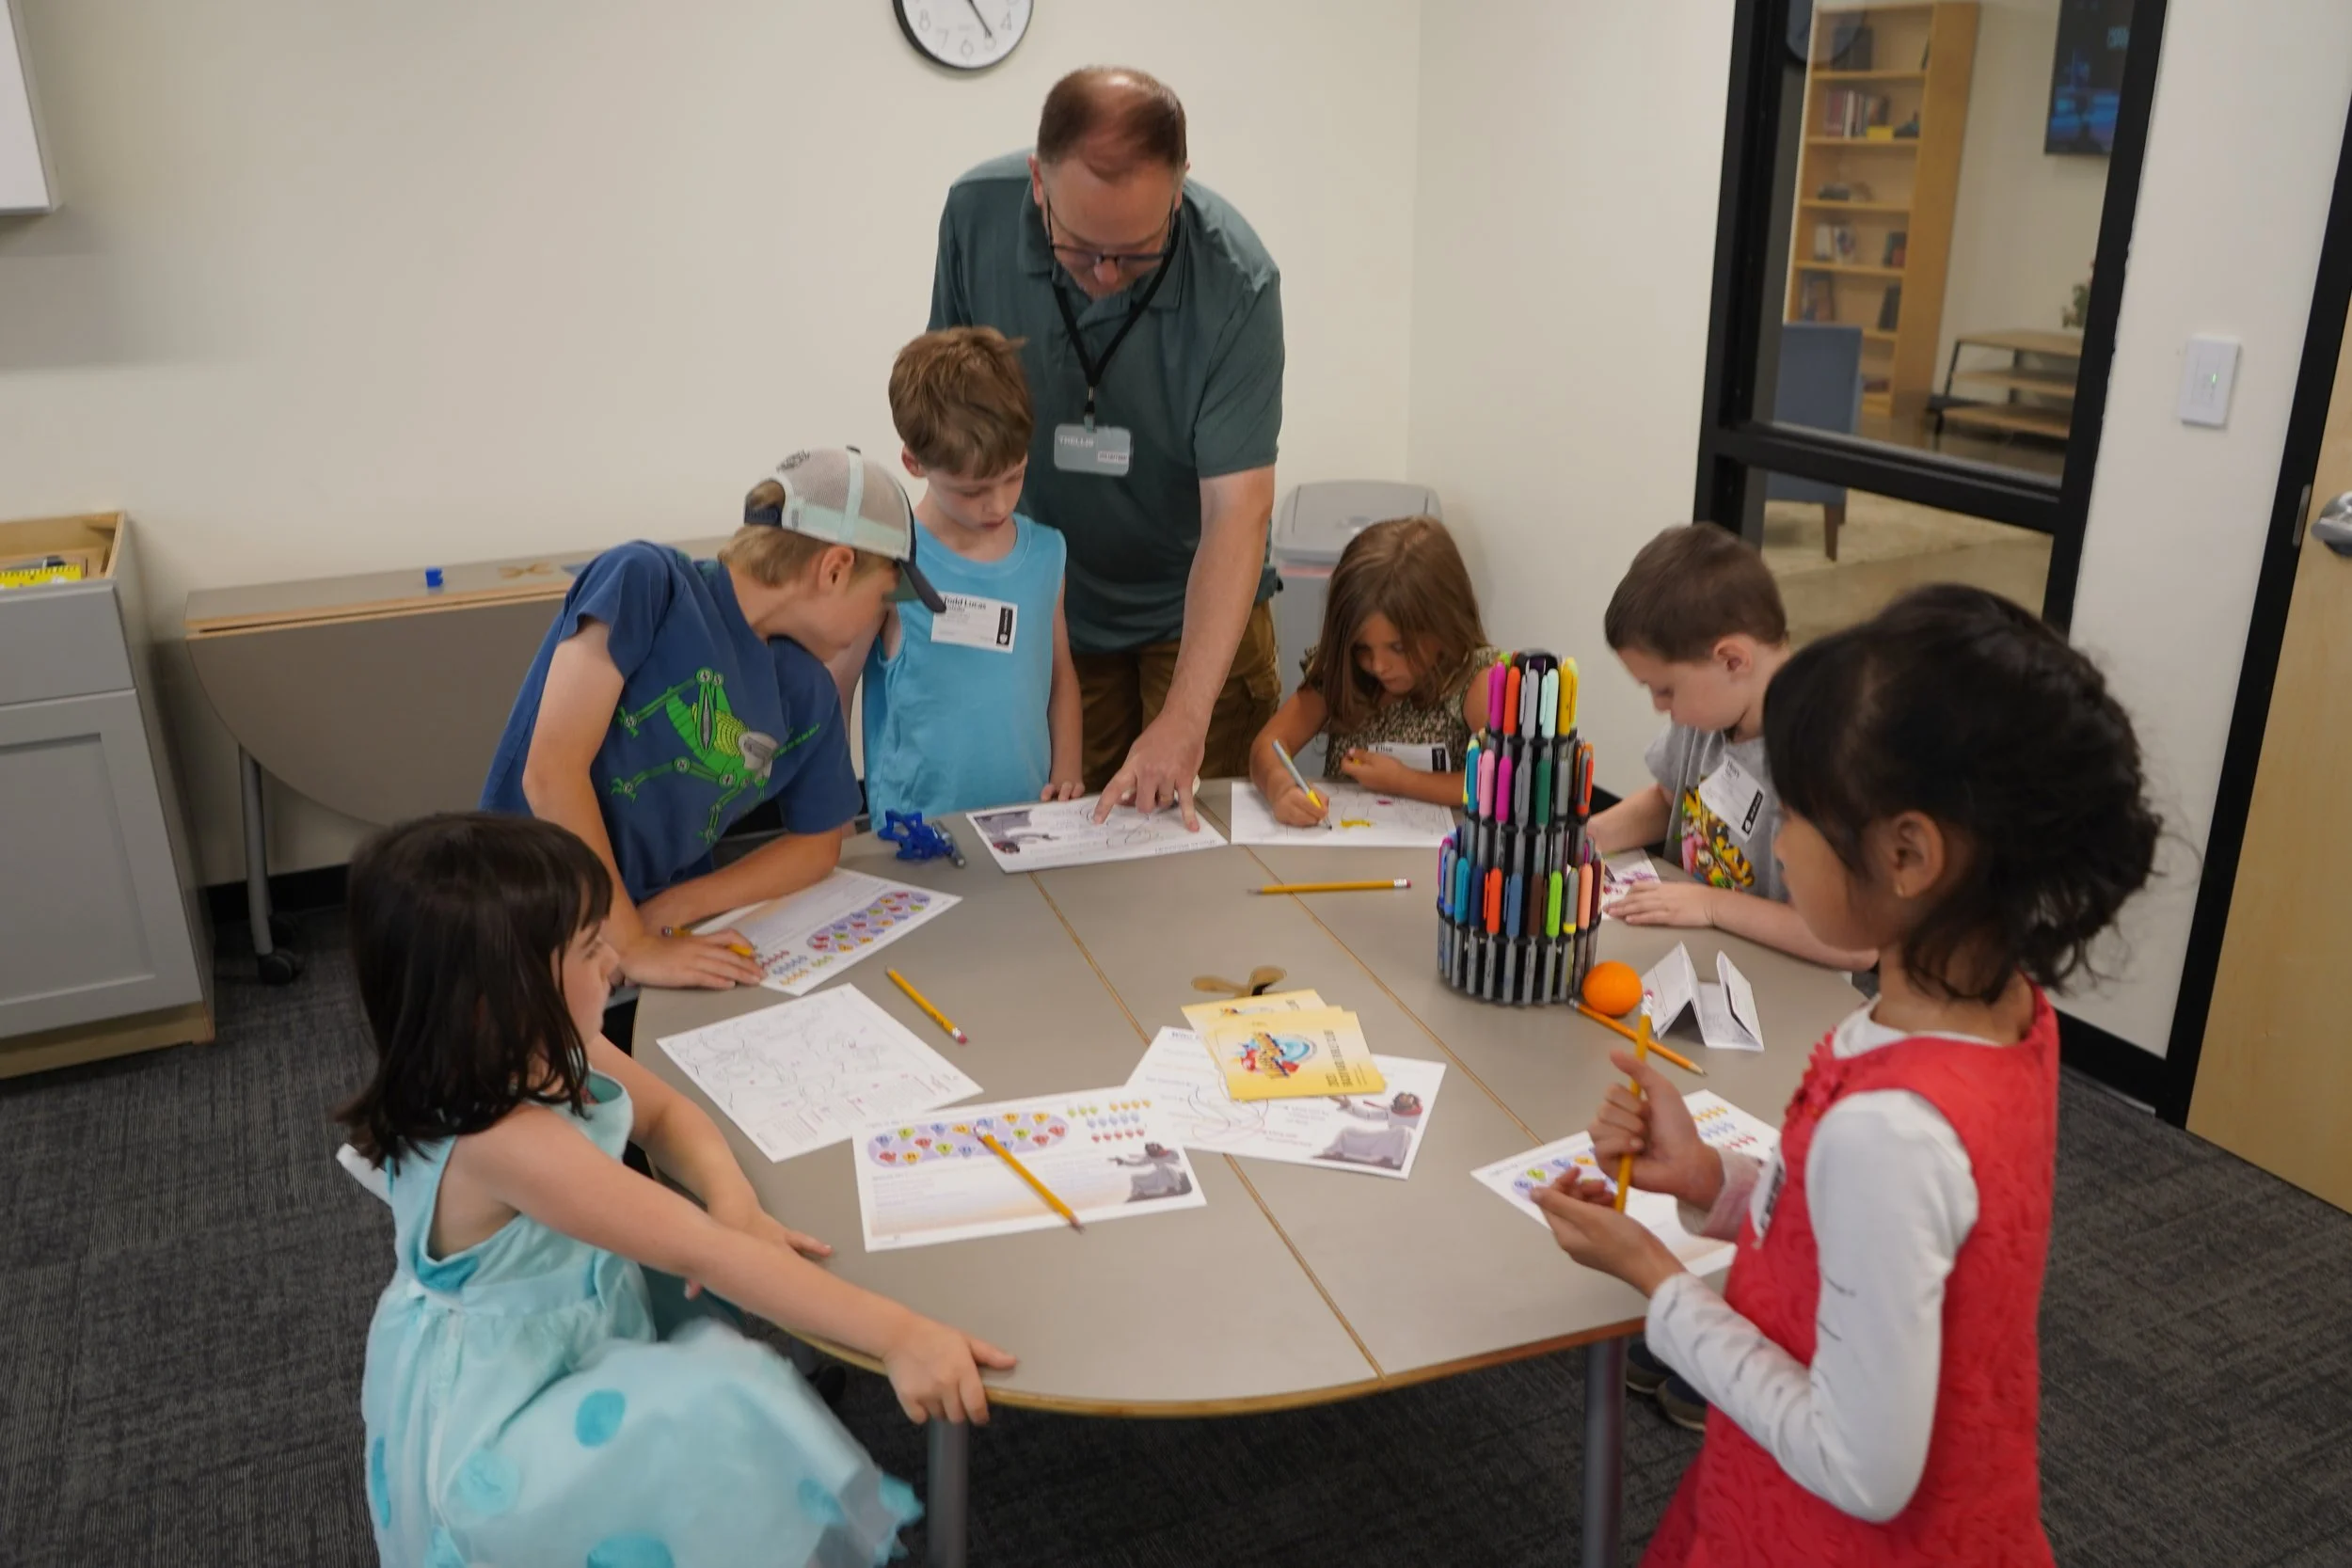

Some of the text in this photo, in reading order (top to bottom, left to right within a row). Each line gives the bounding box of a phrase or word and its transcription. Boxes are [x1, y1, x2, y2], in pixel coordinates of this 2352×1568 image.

[918, 8, 931, 32] 8
[1000, 10, 1012, 31] 4
[936, 27, 949, 49] 7
[960, 37, 974, 58] 6
